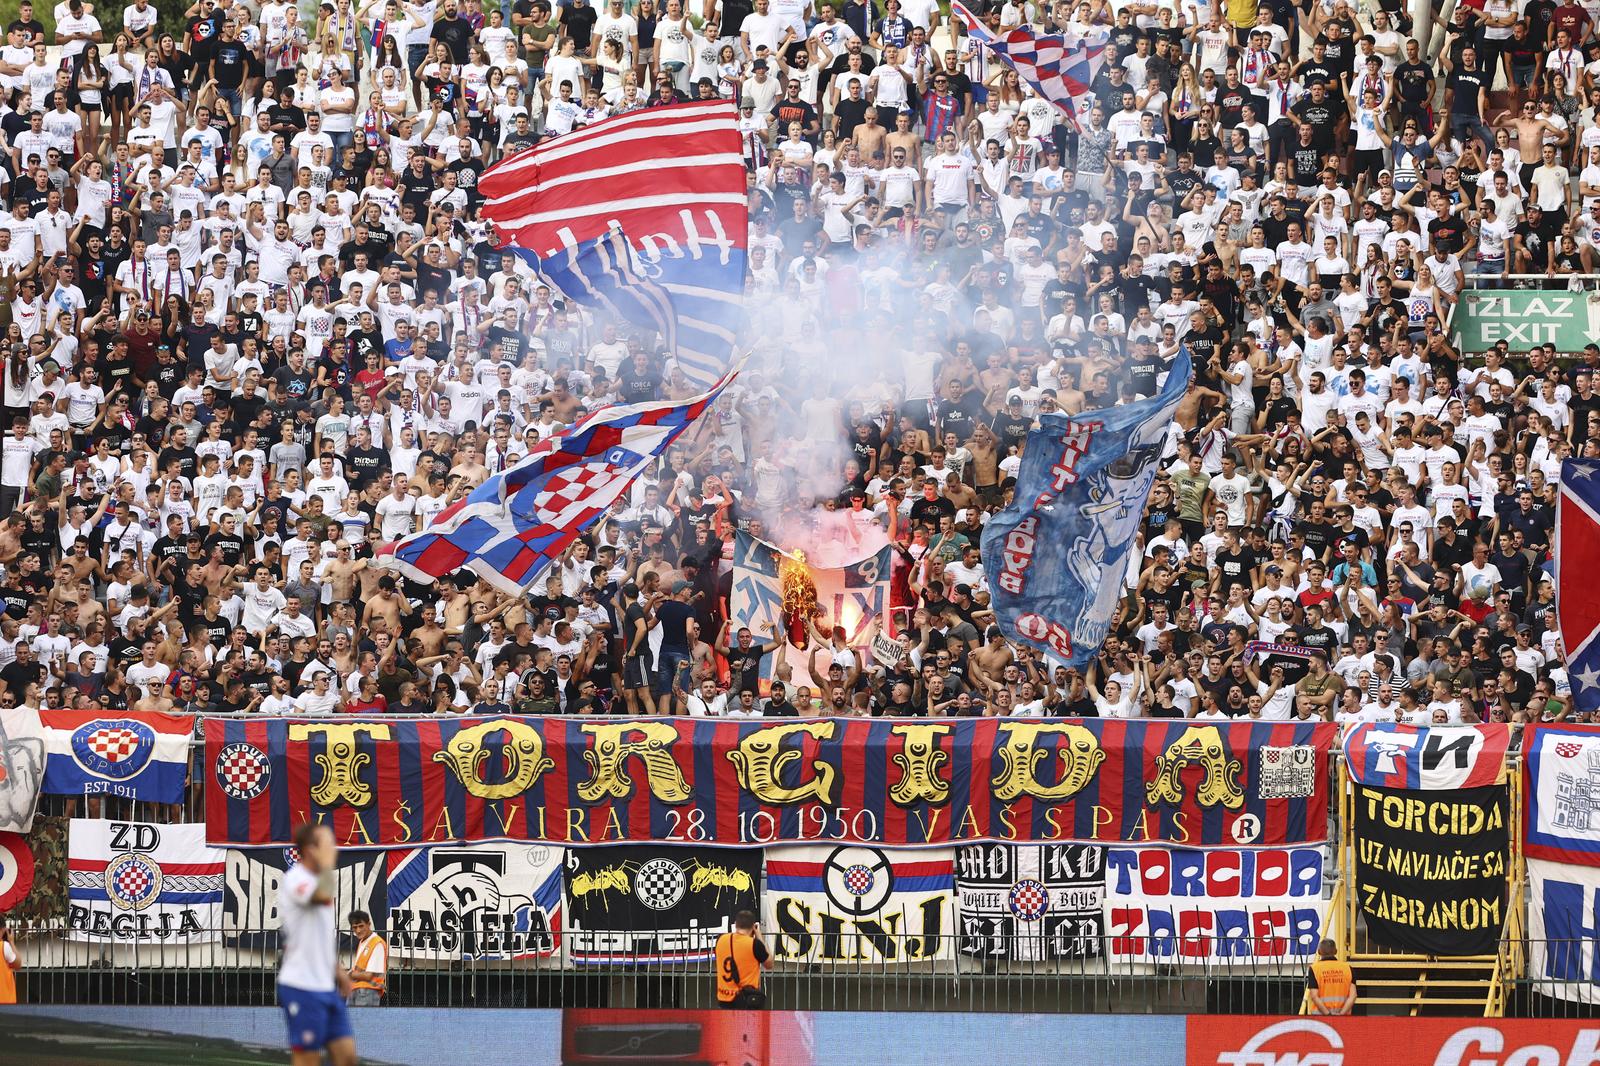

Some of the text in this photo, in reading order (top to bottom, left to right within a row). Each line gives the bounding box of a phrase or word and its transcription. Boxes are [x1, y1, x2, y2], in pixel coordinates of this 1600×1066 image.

[1469, 297, 1574, 317] IZLAZ
[1481, 323, 1562, 342] EXIT
[1267, 643, 1312, 656] HAJDUK
[83, 720, 144, 735] HAJDUK
[220, 744, 265, 762] HAJDUK
[287, 719, 1246, 808] TORCIDA
[84, 754, 136, 777] SPLIT
[224, 784, 262, 798] SPLIT
[1362, 788, 1503, 836] TORCIDA
[490, 804, 625, 842] VIRA
[664, 807, 714, 841] 28.
[738, 809, 777, 843] 10.
[796, 806, 880, 842] 1950.
[110, 823, 160, 853] ZD
[117, 860, 152, 874] HAJDUK
[641, 862, 680, 876] HAJDUK
[1359, 837, 1504, 881] UZ NAVIJAČE SA
[846, 865, 872, 876] HAJDUK
[1107, 850, 1323, 898] TORCIDA
[117, 890, 146, 902] SPLIT
[1012, 880, 1045, 894] HAJDUK
[644, 896, 676, 909] SPLIT
[963, 891, 1097, 909] WHITE BOYS
[1362, 884, 1500, 931] ZABRANOM
[69, 904, 205, 939] REGIJA
[775, 895, 945, 960] SINJ
[569, 915, 737, 952] torcid
[1111, 908, 1320, 958] ZAGREB
[722, 956, 736, 982] 9
